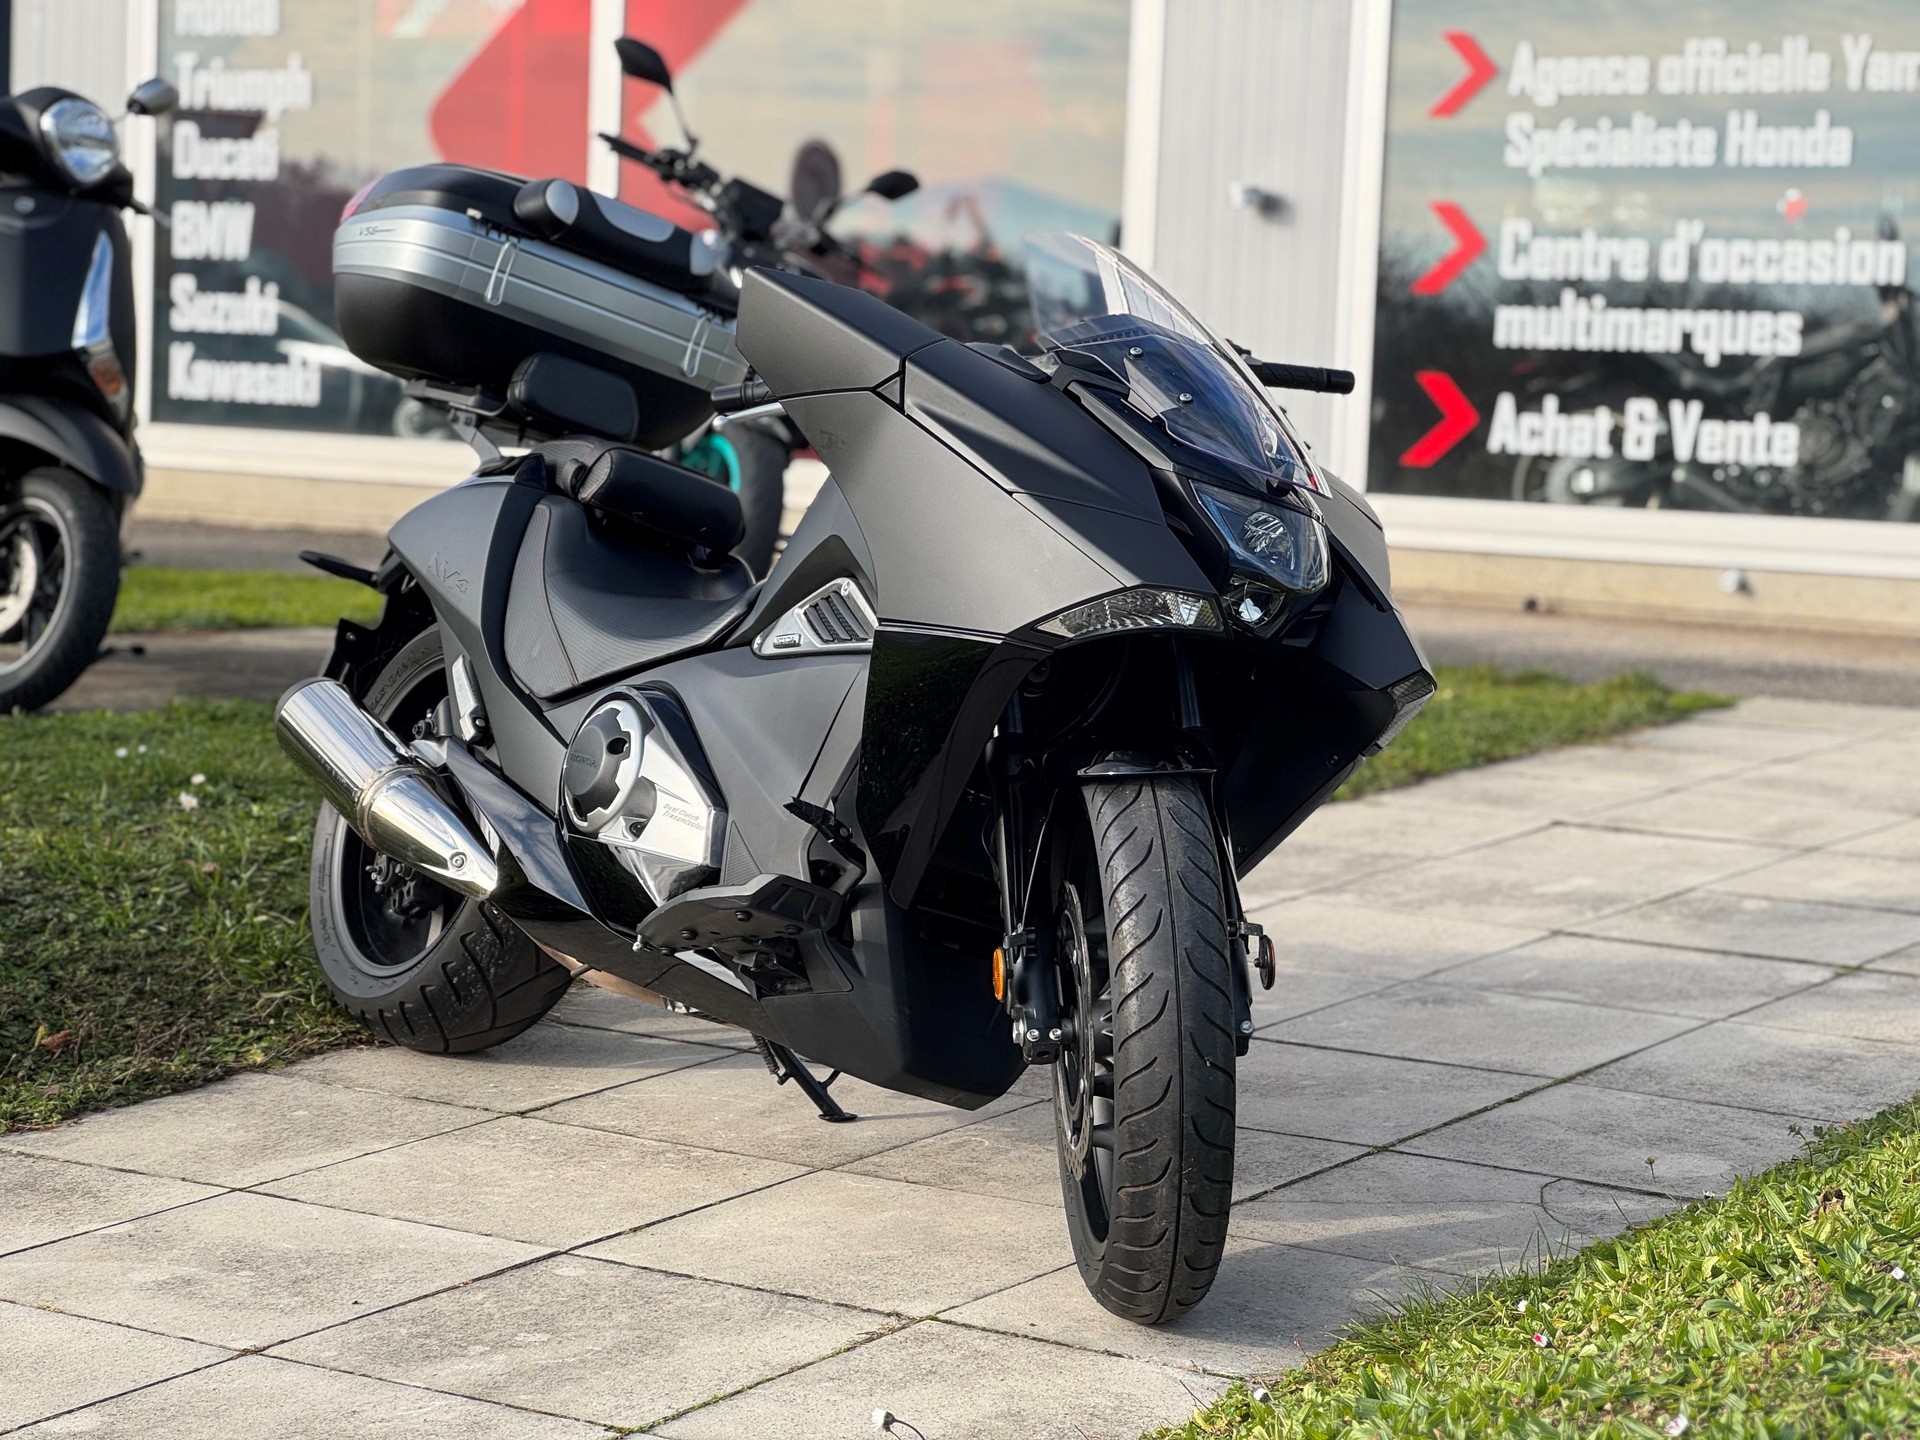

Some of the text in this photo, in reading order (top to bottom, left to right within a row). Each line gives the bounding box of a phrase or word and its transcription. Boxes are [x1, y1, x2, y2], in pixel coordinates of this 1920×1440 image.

[173, 51, 311, 121] Triumph
[1508, 40, 1650, 105] Agence
[1657, 34, 1831, 94] officielle
[172, 120, 279, 180] Ducati
[1504, 109, 1852, 176] Spécialiste Honda
[171, 201, 255, 260] BMW
[1500, 218, 1906, 286] Centre d'occasion
[170, 273, 279, 335] Suzuki
[1493, 287, 1803, 367] multimarques
[168, 341, 321, 407] Kawasaki
[1487, 392, 1799, 468] Achat & Vente
[570, 753, 598, 769] HONDA
[662, 810, 705, 831] Transmission
[663, 803, 700, 821] Dual Clutch
